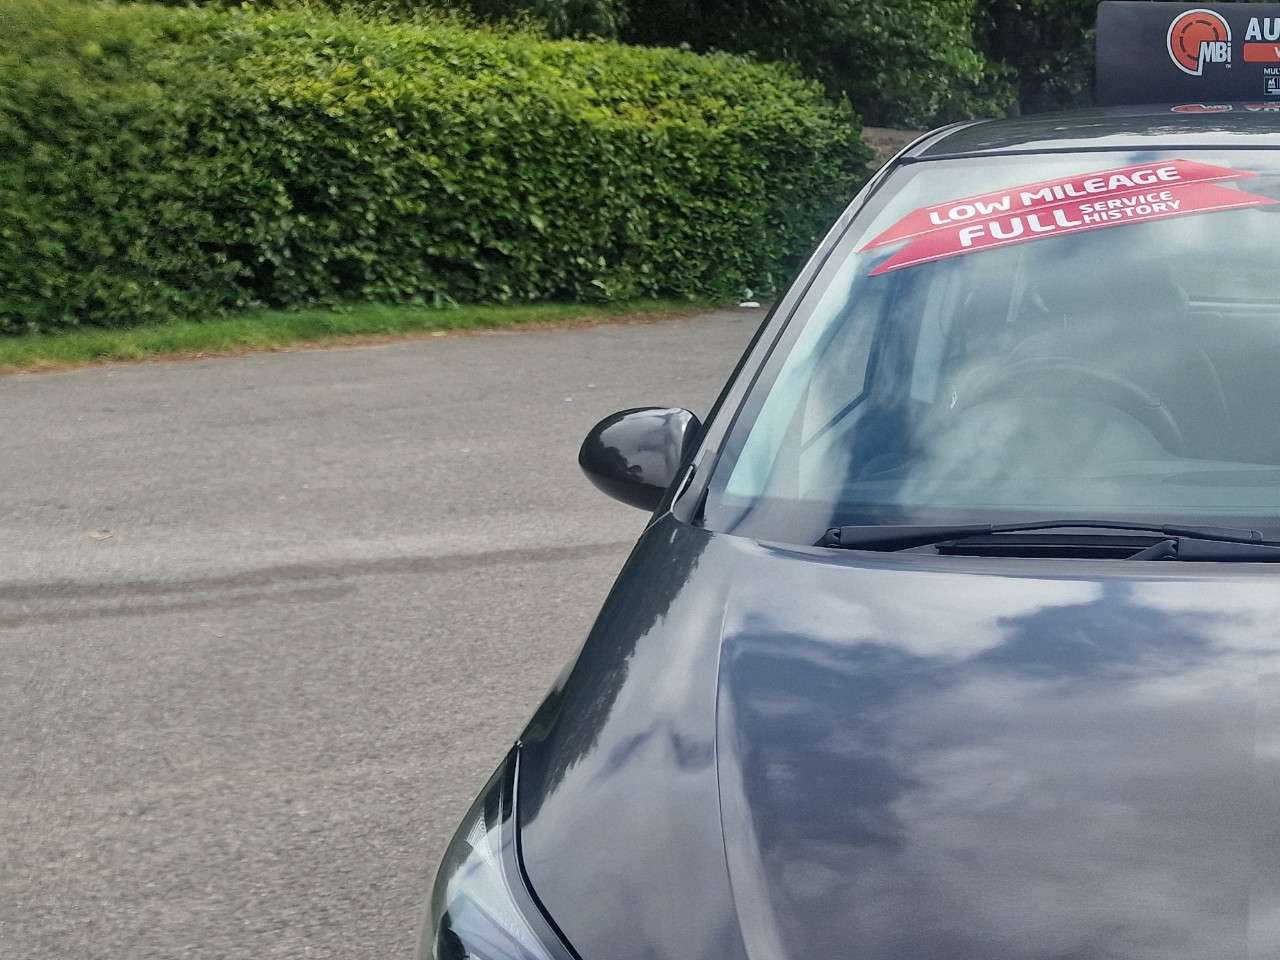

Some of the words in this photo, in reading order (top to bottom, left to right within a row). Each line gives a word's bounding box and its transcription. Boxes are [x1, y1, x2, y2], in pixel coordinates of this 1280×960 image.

[929, 195, 1011, 226] LOW
[1020, 166, 1181, 206] MILEAGE
[1080, 190, 1174, 214] SERVICE
[1082, 199, 1182, 224] HISTORY
[958, 208, 1082, 248] FULL
